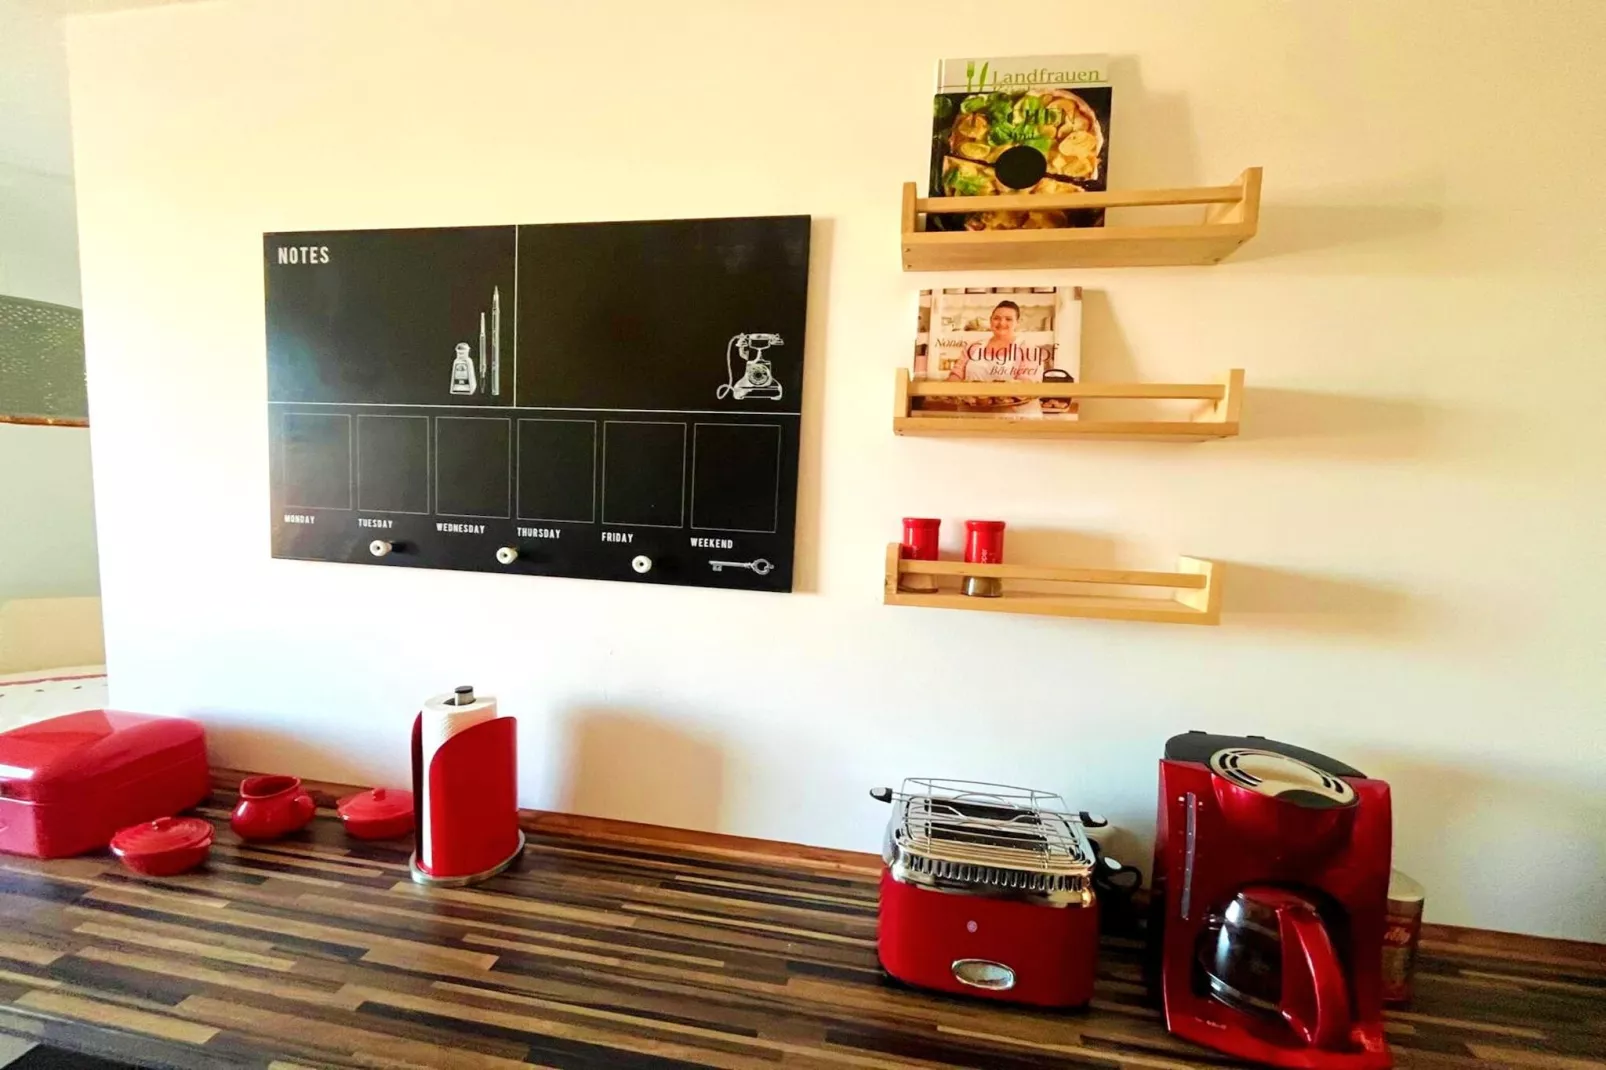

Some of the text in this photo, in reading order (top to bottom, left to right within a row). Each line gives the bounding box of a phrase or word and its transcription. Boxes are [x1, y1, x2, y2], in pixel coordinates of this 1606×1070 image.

[993, 68, 1100, 85] Landfrauen
[278, 246, 330, 265] NOTES
[967, 342, 1060, 366] Guglhupf
[284, 514, 316, 524] MONDAY
[358, 518, 393, 529] TUESDAY
[436, 522, 485, 534] WEDNESDAY
[517, 527, 561, 539] THURSDAY
[601, 532, 634, 543] FRIDAY
[690, 537, 734, 549] WEEKEND
